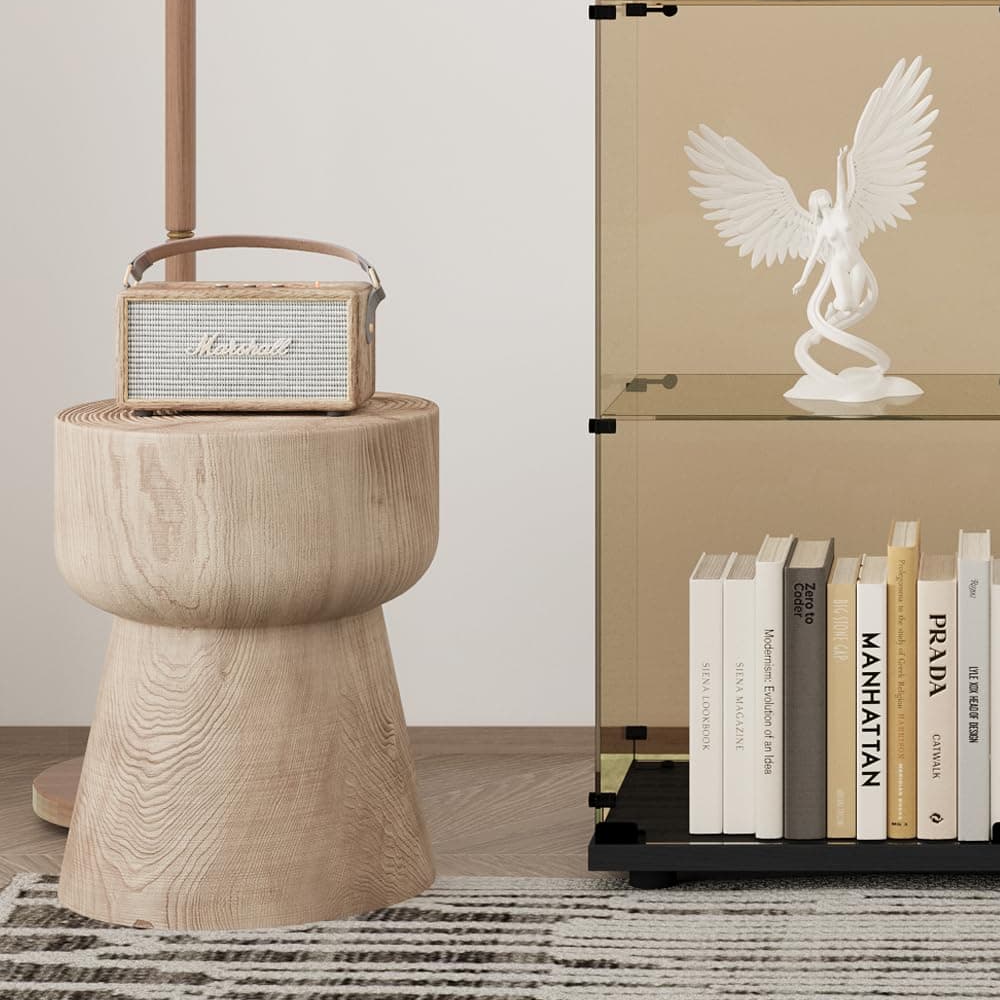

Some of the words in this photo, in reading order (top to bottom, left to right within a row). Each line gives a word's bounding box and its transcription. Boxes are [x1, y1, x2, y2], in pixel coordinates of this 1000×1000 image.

[187, 333, 293, 357] Marshall
[794, 583, 804, 618] Coder
[805, 582, 816, 610] Zero
[805, 612, 816, 625] to
[929, 614, 947, 697] PRADA
[702, 662, 711, 692] SIENA
[735, 662, 745, 692] SIENA
[969, 666, 979, 680] LYLE
[764, 686, 775, 726] Evolution
[861, 633, 881, 786] MANHATTAN
[969, 695, 979, 711] HEAD
[969, 711, 979, 720] OF
[702, 696, 711, 751] LOOKBOOK
[735, 696, 745, 751] MAGAZINE
[969, 721, 979, 743] DESIGN
[764, 741, 773, 752] an
[932, 734, 941, 779] CATWALK
[764, 755, 775, 775] Idea
